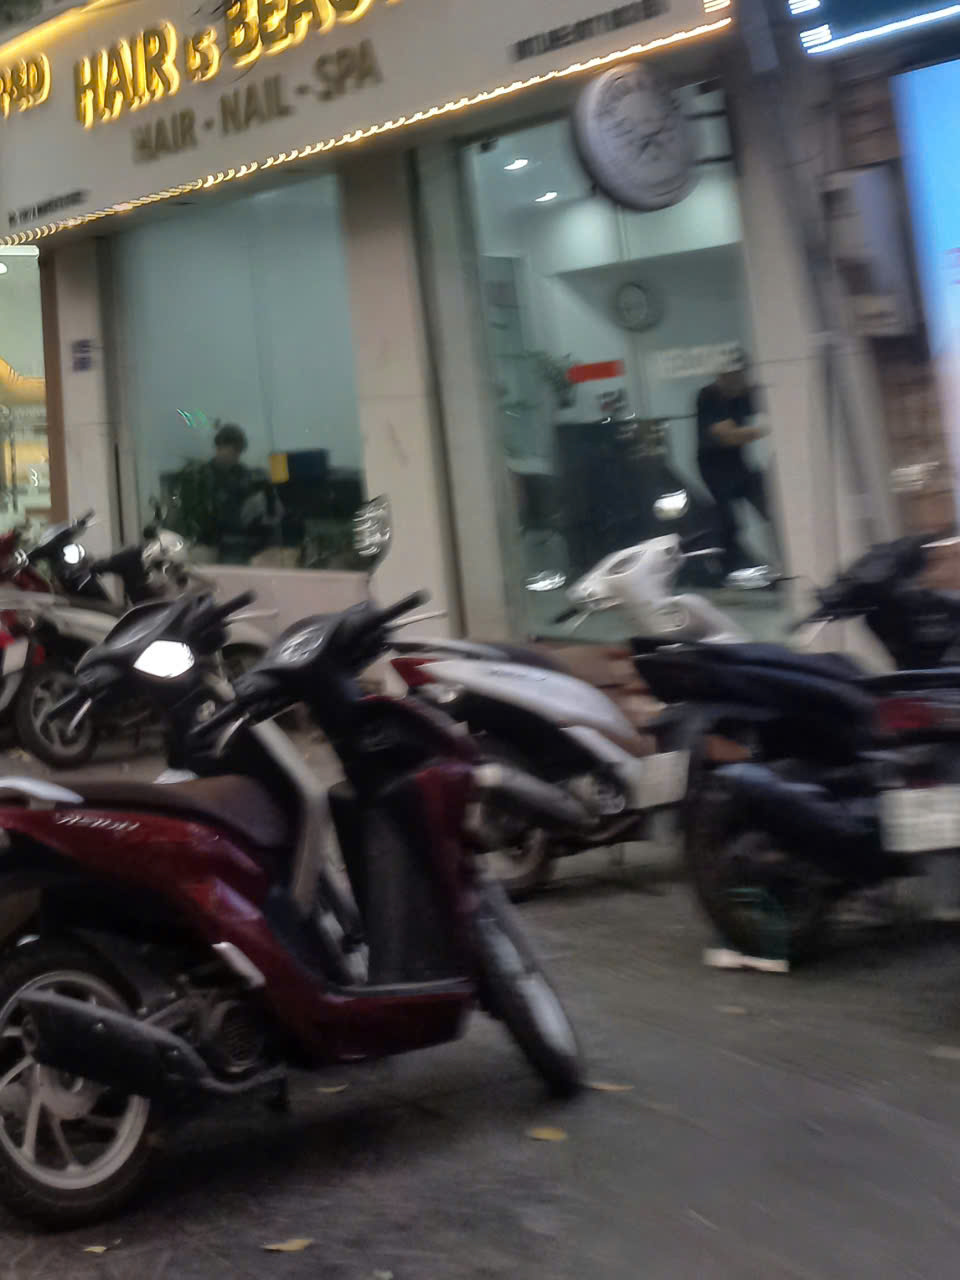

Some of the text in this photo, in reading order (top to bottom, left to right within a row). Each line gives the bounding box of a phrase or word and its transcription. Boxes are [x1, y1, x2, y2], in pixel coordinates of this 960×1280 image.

[74, 21, 180, 128] HAIR
[132, 106, 198, 163] HAIR
[220, 73, 295, 135] NAIL
[313, 38, 383, 102] SPA
